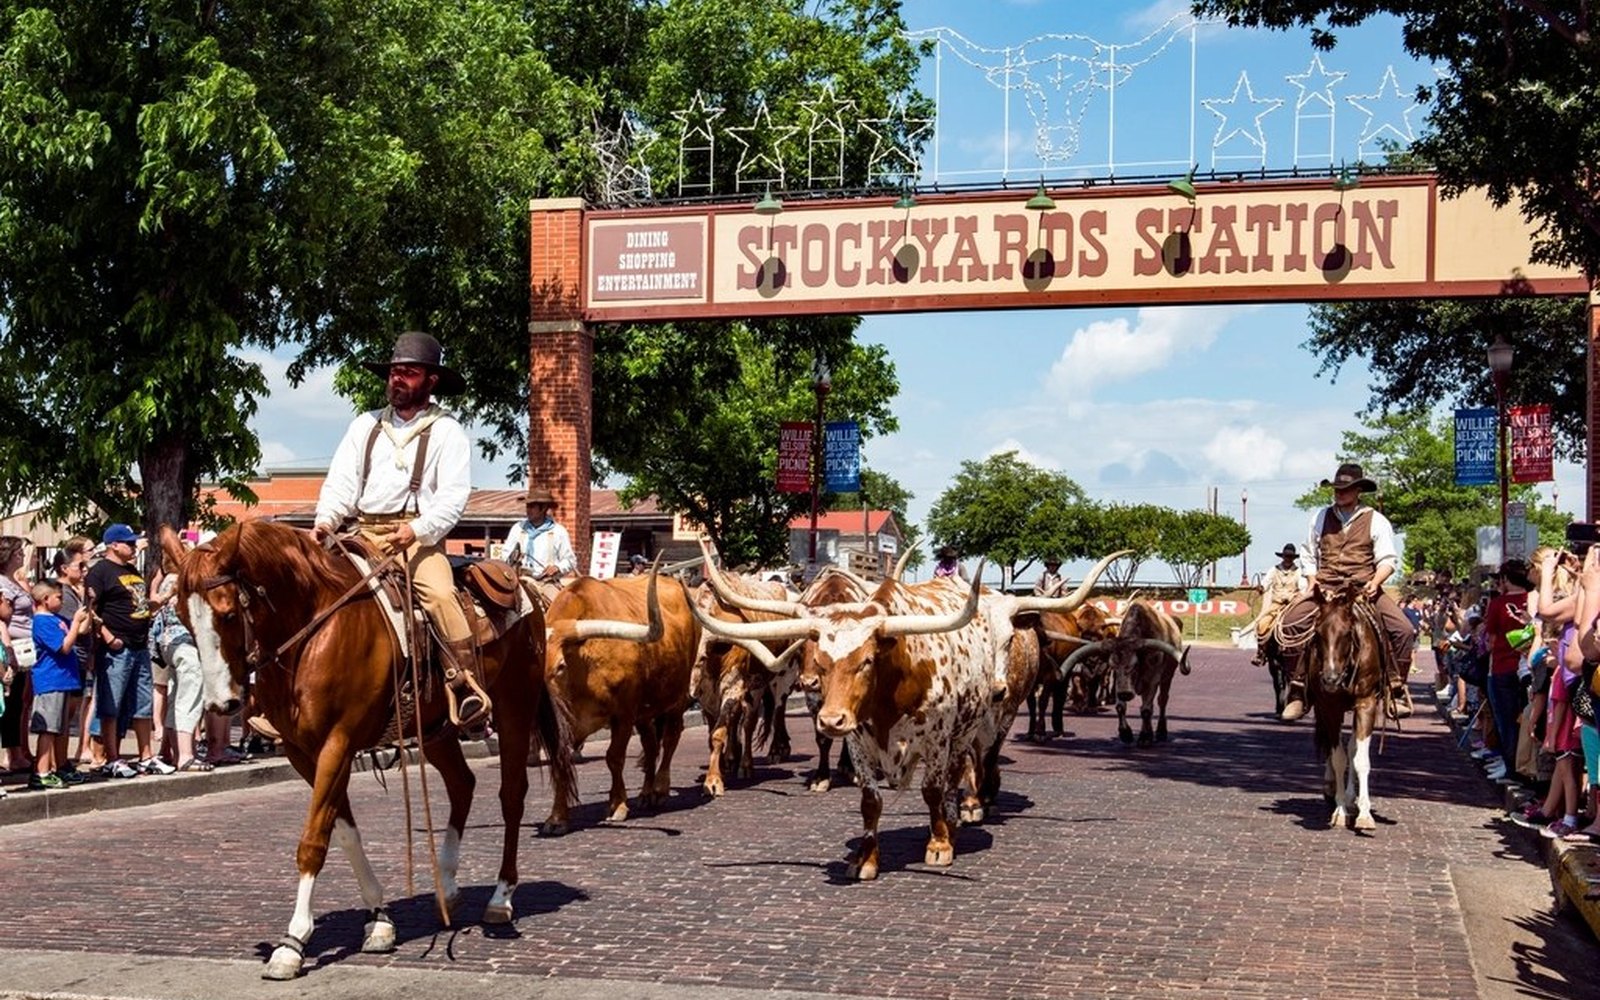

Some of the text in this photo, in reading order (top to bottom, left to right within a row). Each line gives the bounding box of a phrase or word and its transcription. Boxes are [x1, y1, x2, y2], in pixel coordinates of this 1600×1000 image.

[626, 231, 669, 248] DINING
[736, 200, 1399, 290] STOCKYARDS STATION
[619, 252, 676, 269] SHOPPING
[597, 273, 699, 291] ENTERTAINMENT
[1456, 416, 1496, 430] WILLIE
[1511, 413, 1551, 428] WILLIE
[780, 430, 813, 441] WILLIE
[826, 429, 859, 441] WILLIE
[1456, 449, 1495, 462] PICNIC
[1513, 445, 1552, 460] PICNIC
[779, 459, 809, 471] PICNIC
[826, 459, 859, 471] PICNIC
